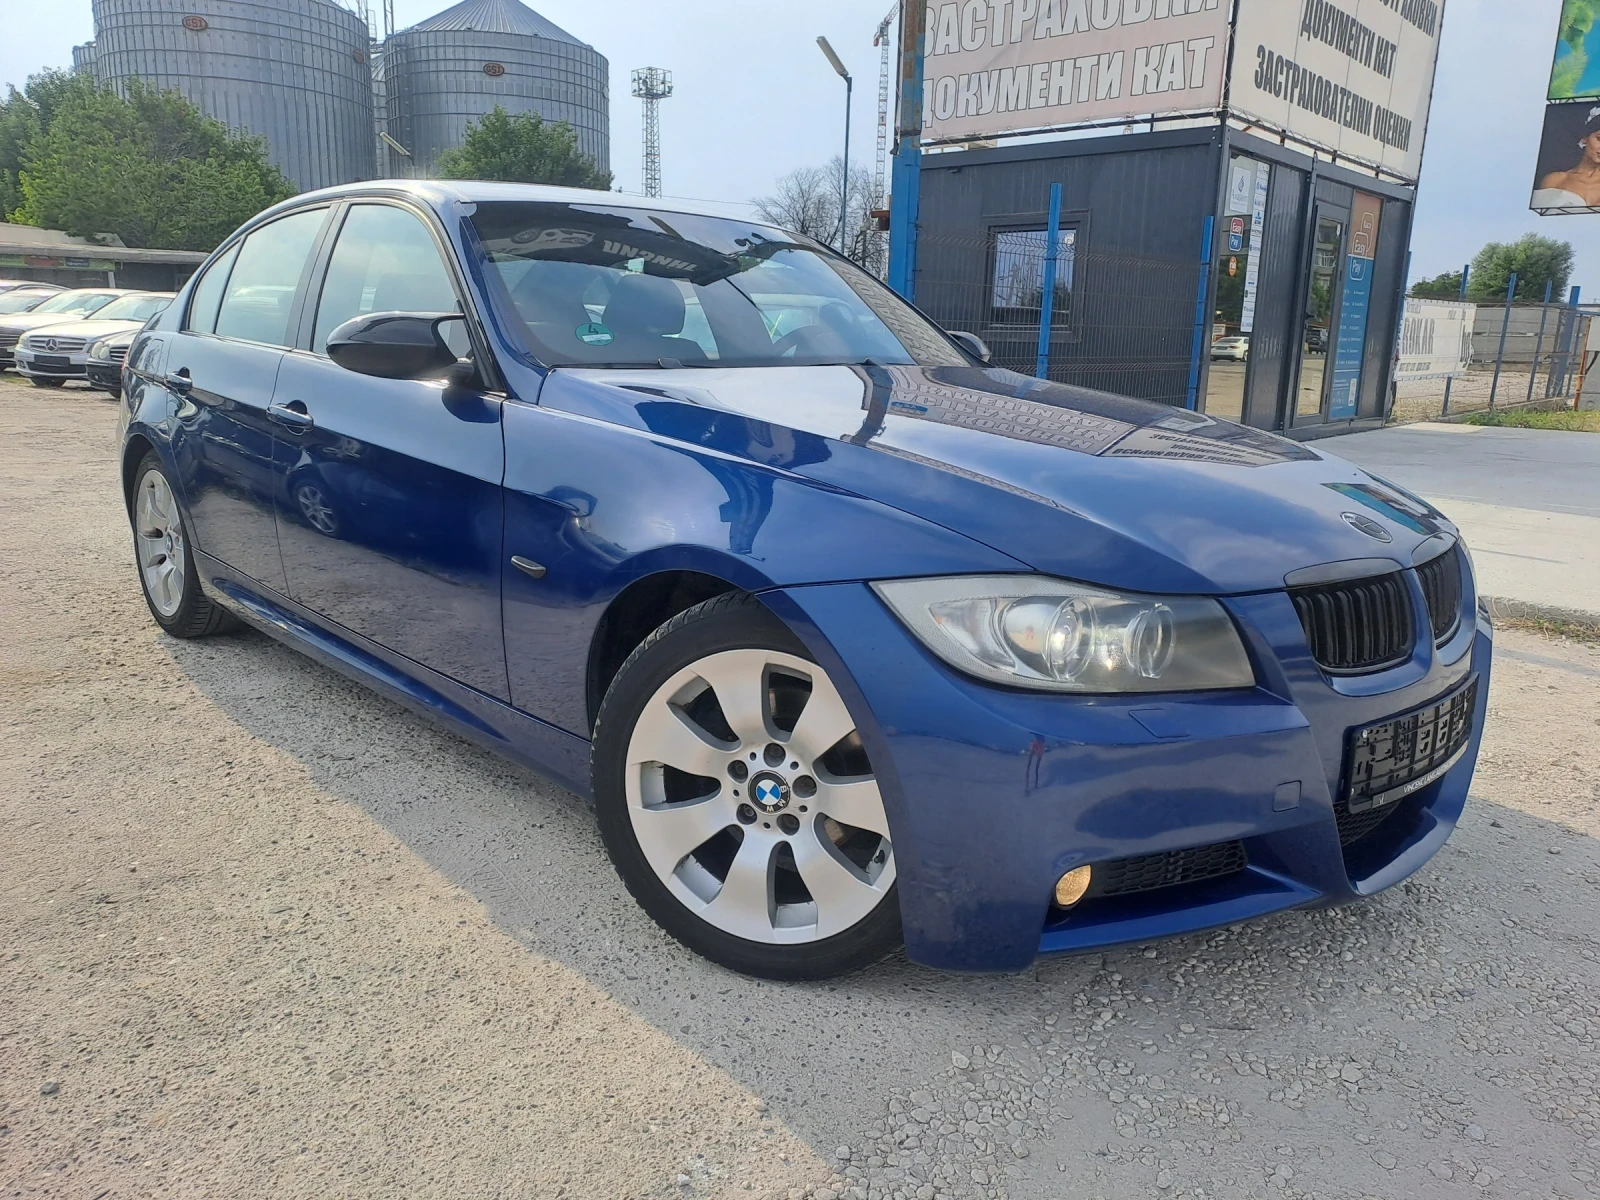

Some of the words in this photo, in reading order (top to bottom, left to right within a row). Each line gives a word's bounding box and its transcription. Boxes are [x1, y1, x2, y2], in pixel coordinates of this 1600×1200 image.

[1130, 36, 1215, 97] КАТ
[1300, 0, 1375, 68] ДОКУМЕНТИ
[1373, 35, 1397, 79] КАТ
[1254, 44, 1373, 137] ЗАСТРАХОВАТЕЛНИ
[1373, 104, 1412, 152] ОЦЕНКИ
